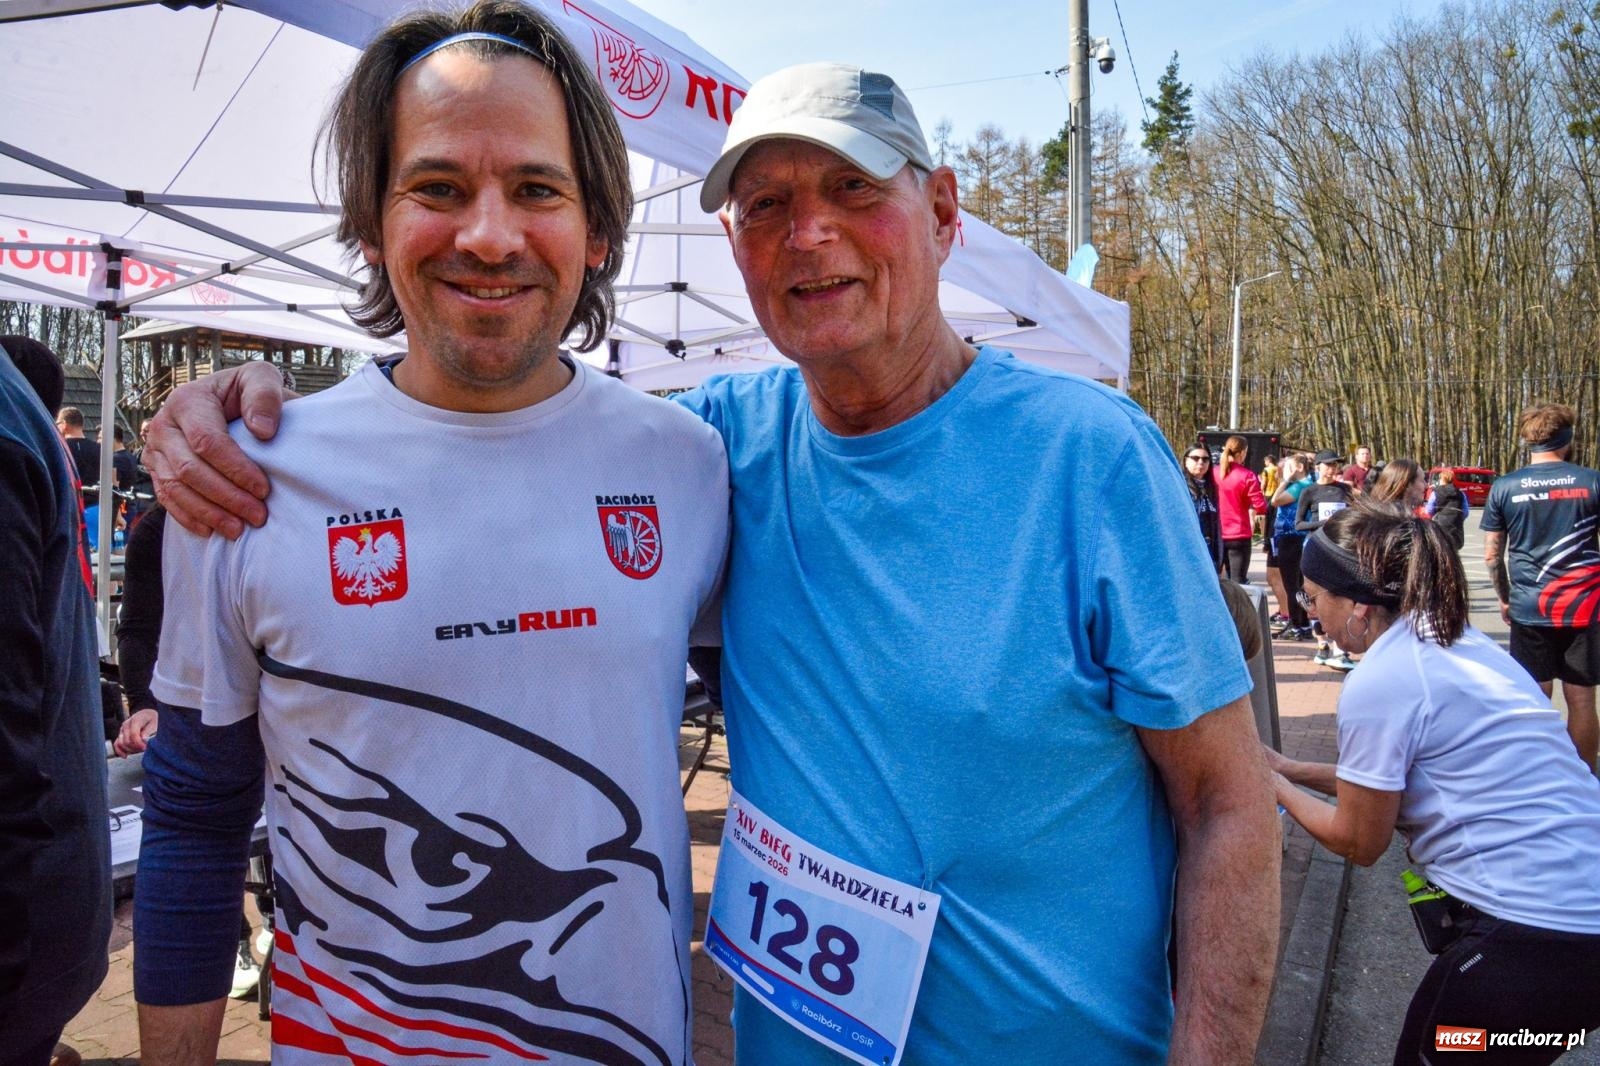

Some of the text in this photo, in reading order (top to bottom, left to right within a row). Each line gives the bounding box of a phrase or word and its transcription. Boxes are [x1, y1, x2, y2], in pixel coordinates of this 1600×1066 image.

[326, 507, 403, 527] POLSKA
[595, 493, 656, 506] RACIBÓRZ
[733, 828, 789, 877] 15 marzec 2026
[736, 808, 915, 919] XIV BIEG TWARDZIELA
[747, 880, 861, 996] 128
[801, 1003, 842, 1033] Racibórz
